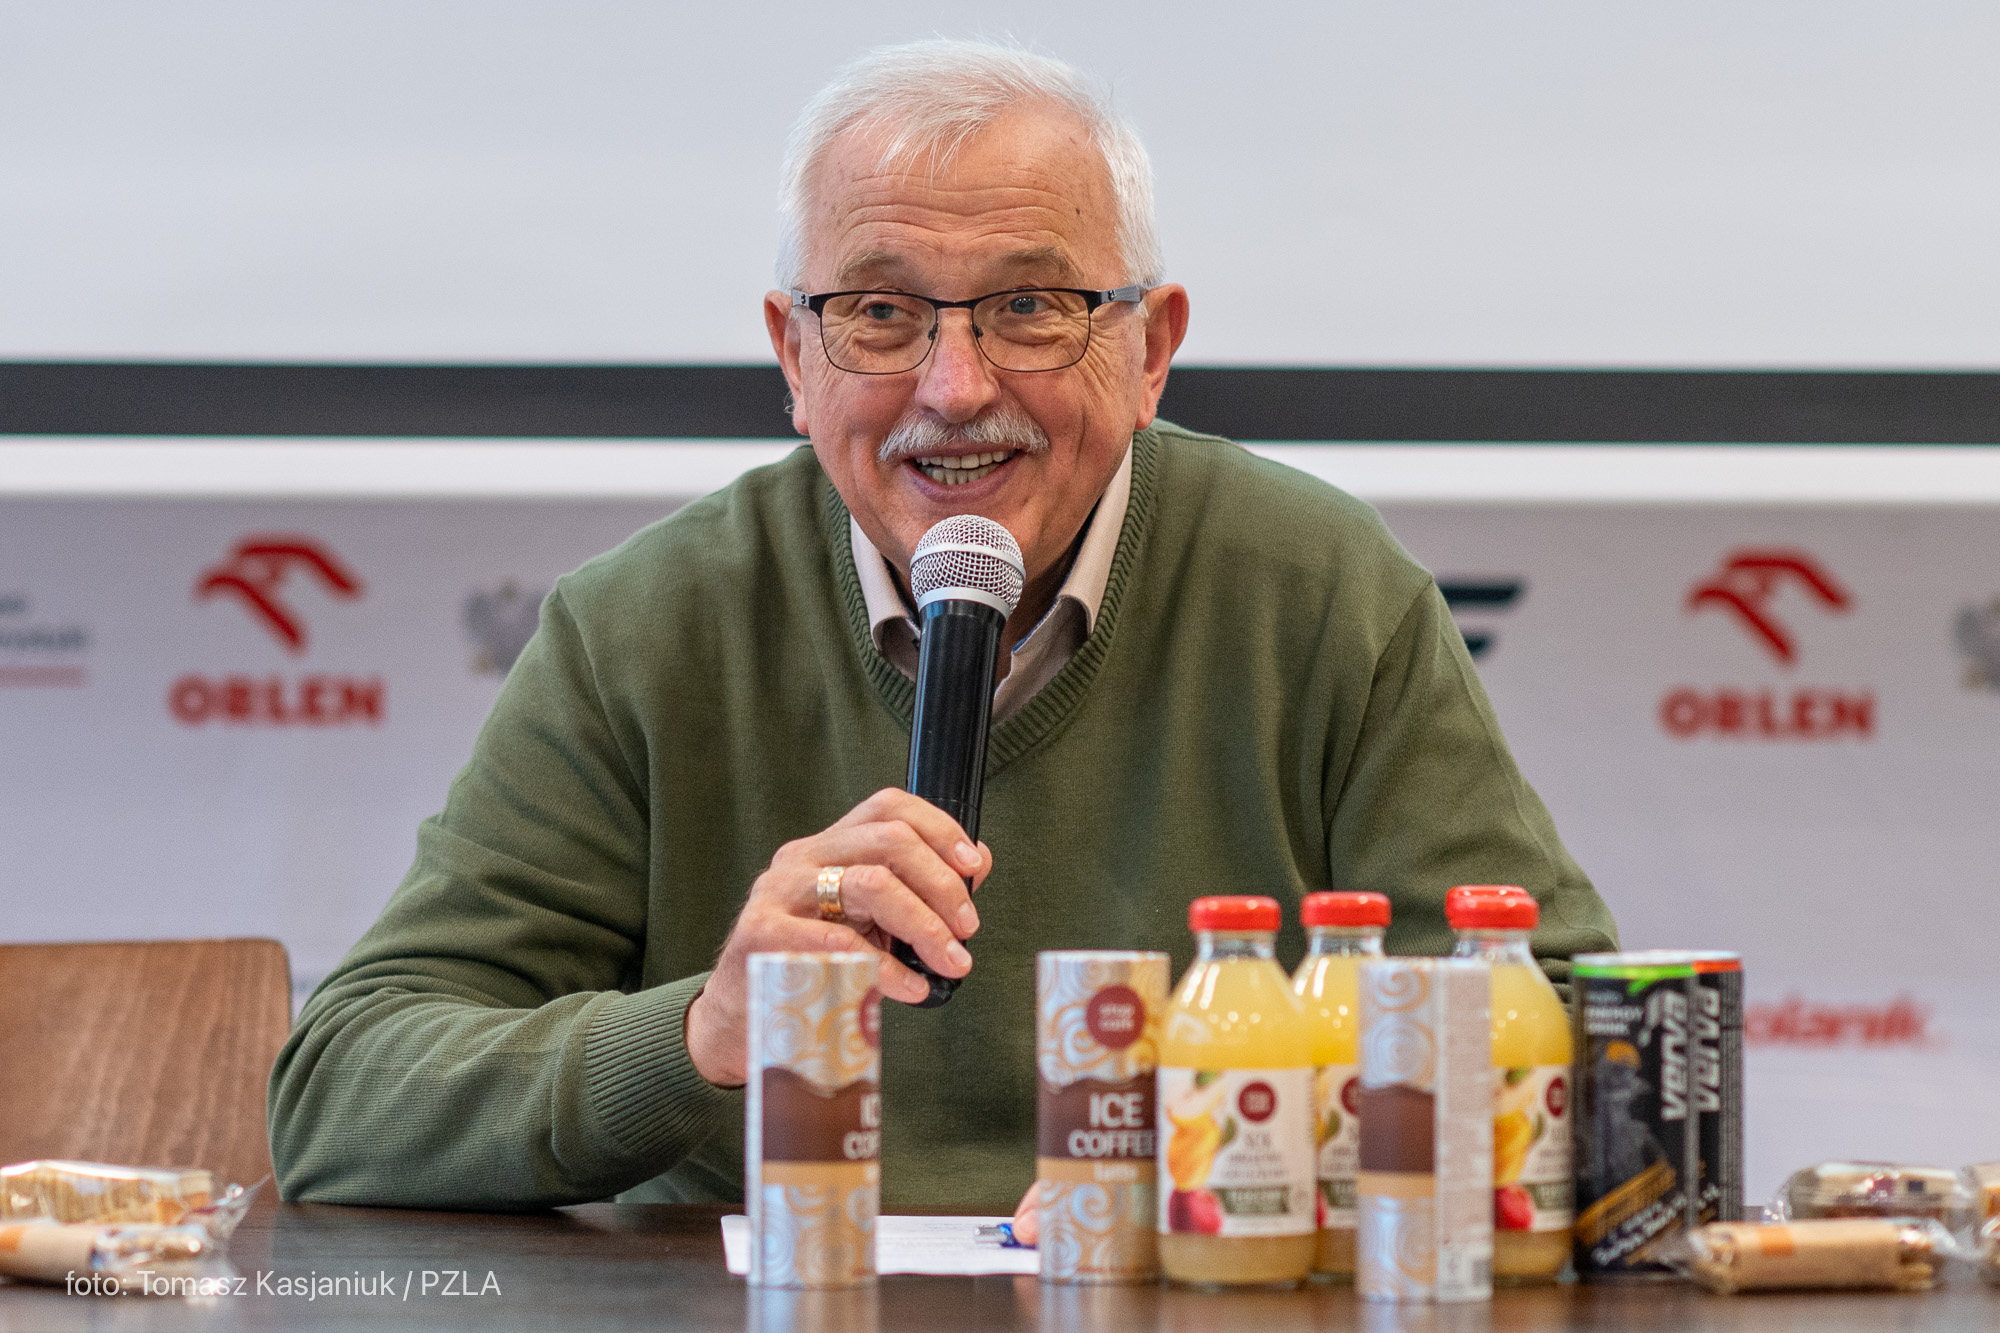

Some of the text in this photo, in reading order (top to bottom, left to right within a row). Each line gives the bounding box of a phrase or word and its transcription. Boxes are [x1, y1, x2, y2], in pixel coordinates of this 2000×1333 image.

[169, 675, 385, 726] ORLEN
[1659, 687, 1876, 739] ORLEN
[1089, 1093, 1143, 1127] ICE
